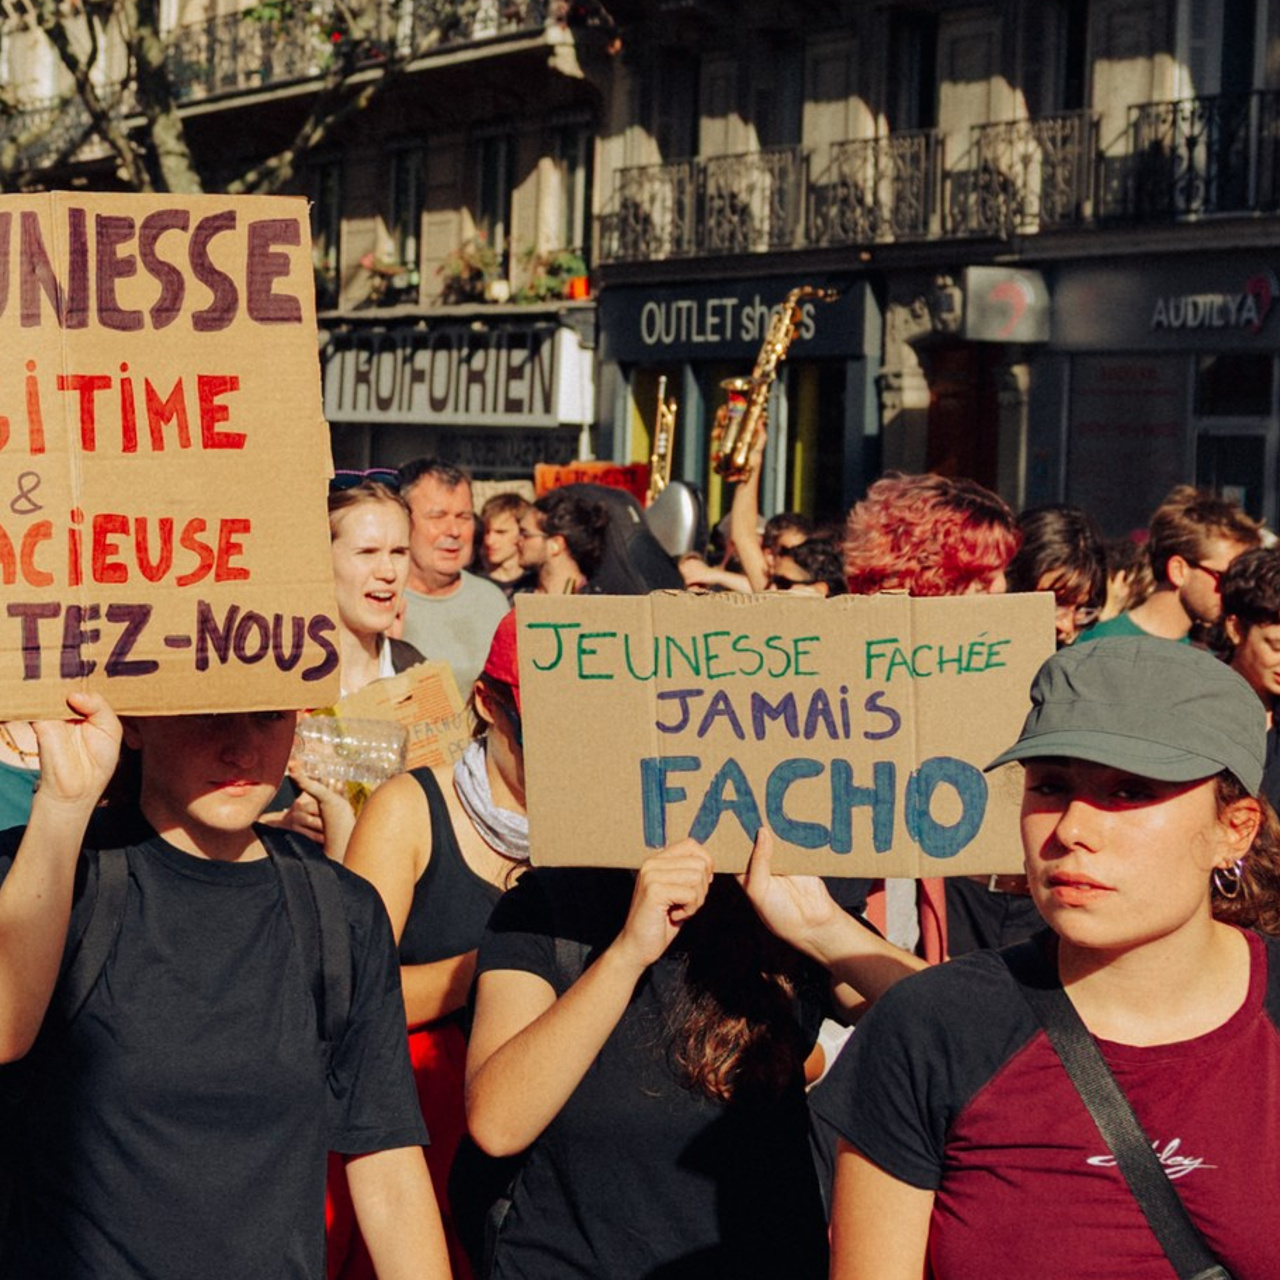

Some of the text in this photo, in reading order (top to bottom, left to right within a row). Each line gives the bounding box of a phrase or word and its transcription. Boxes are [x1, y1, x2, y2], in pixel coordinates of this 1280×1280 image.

[641, 297, 738, 345] OUTLET
[9, 471, 43, 515] &
[526, 621, 1012, 683] JEUNESSE FACHÉE
[639, 755, 990, 859] FACHO
